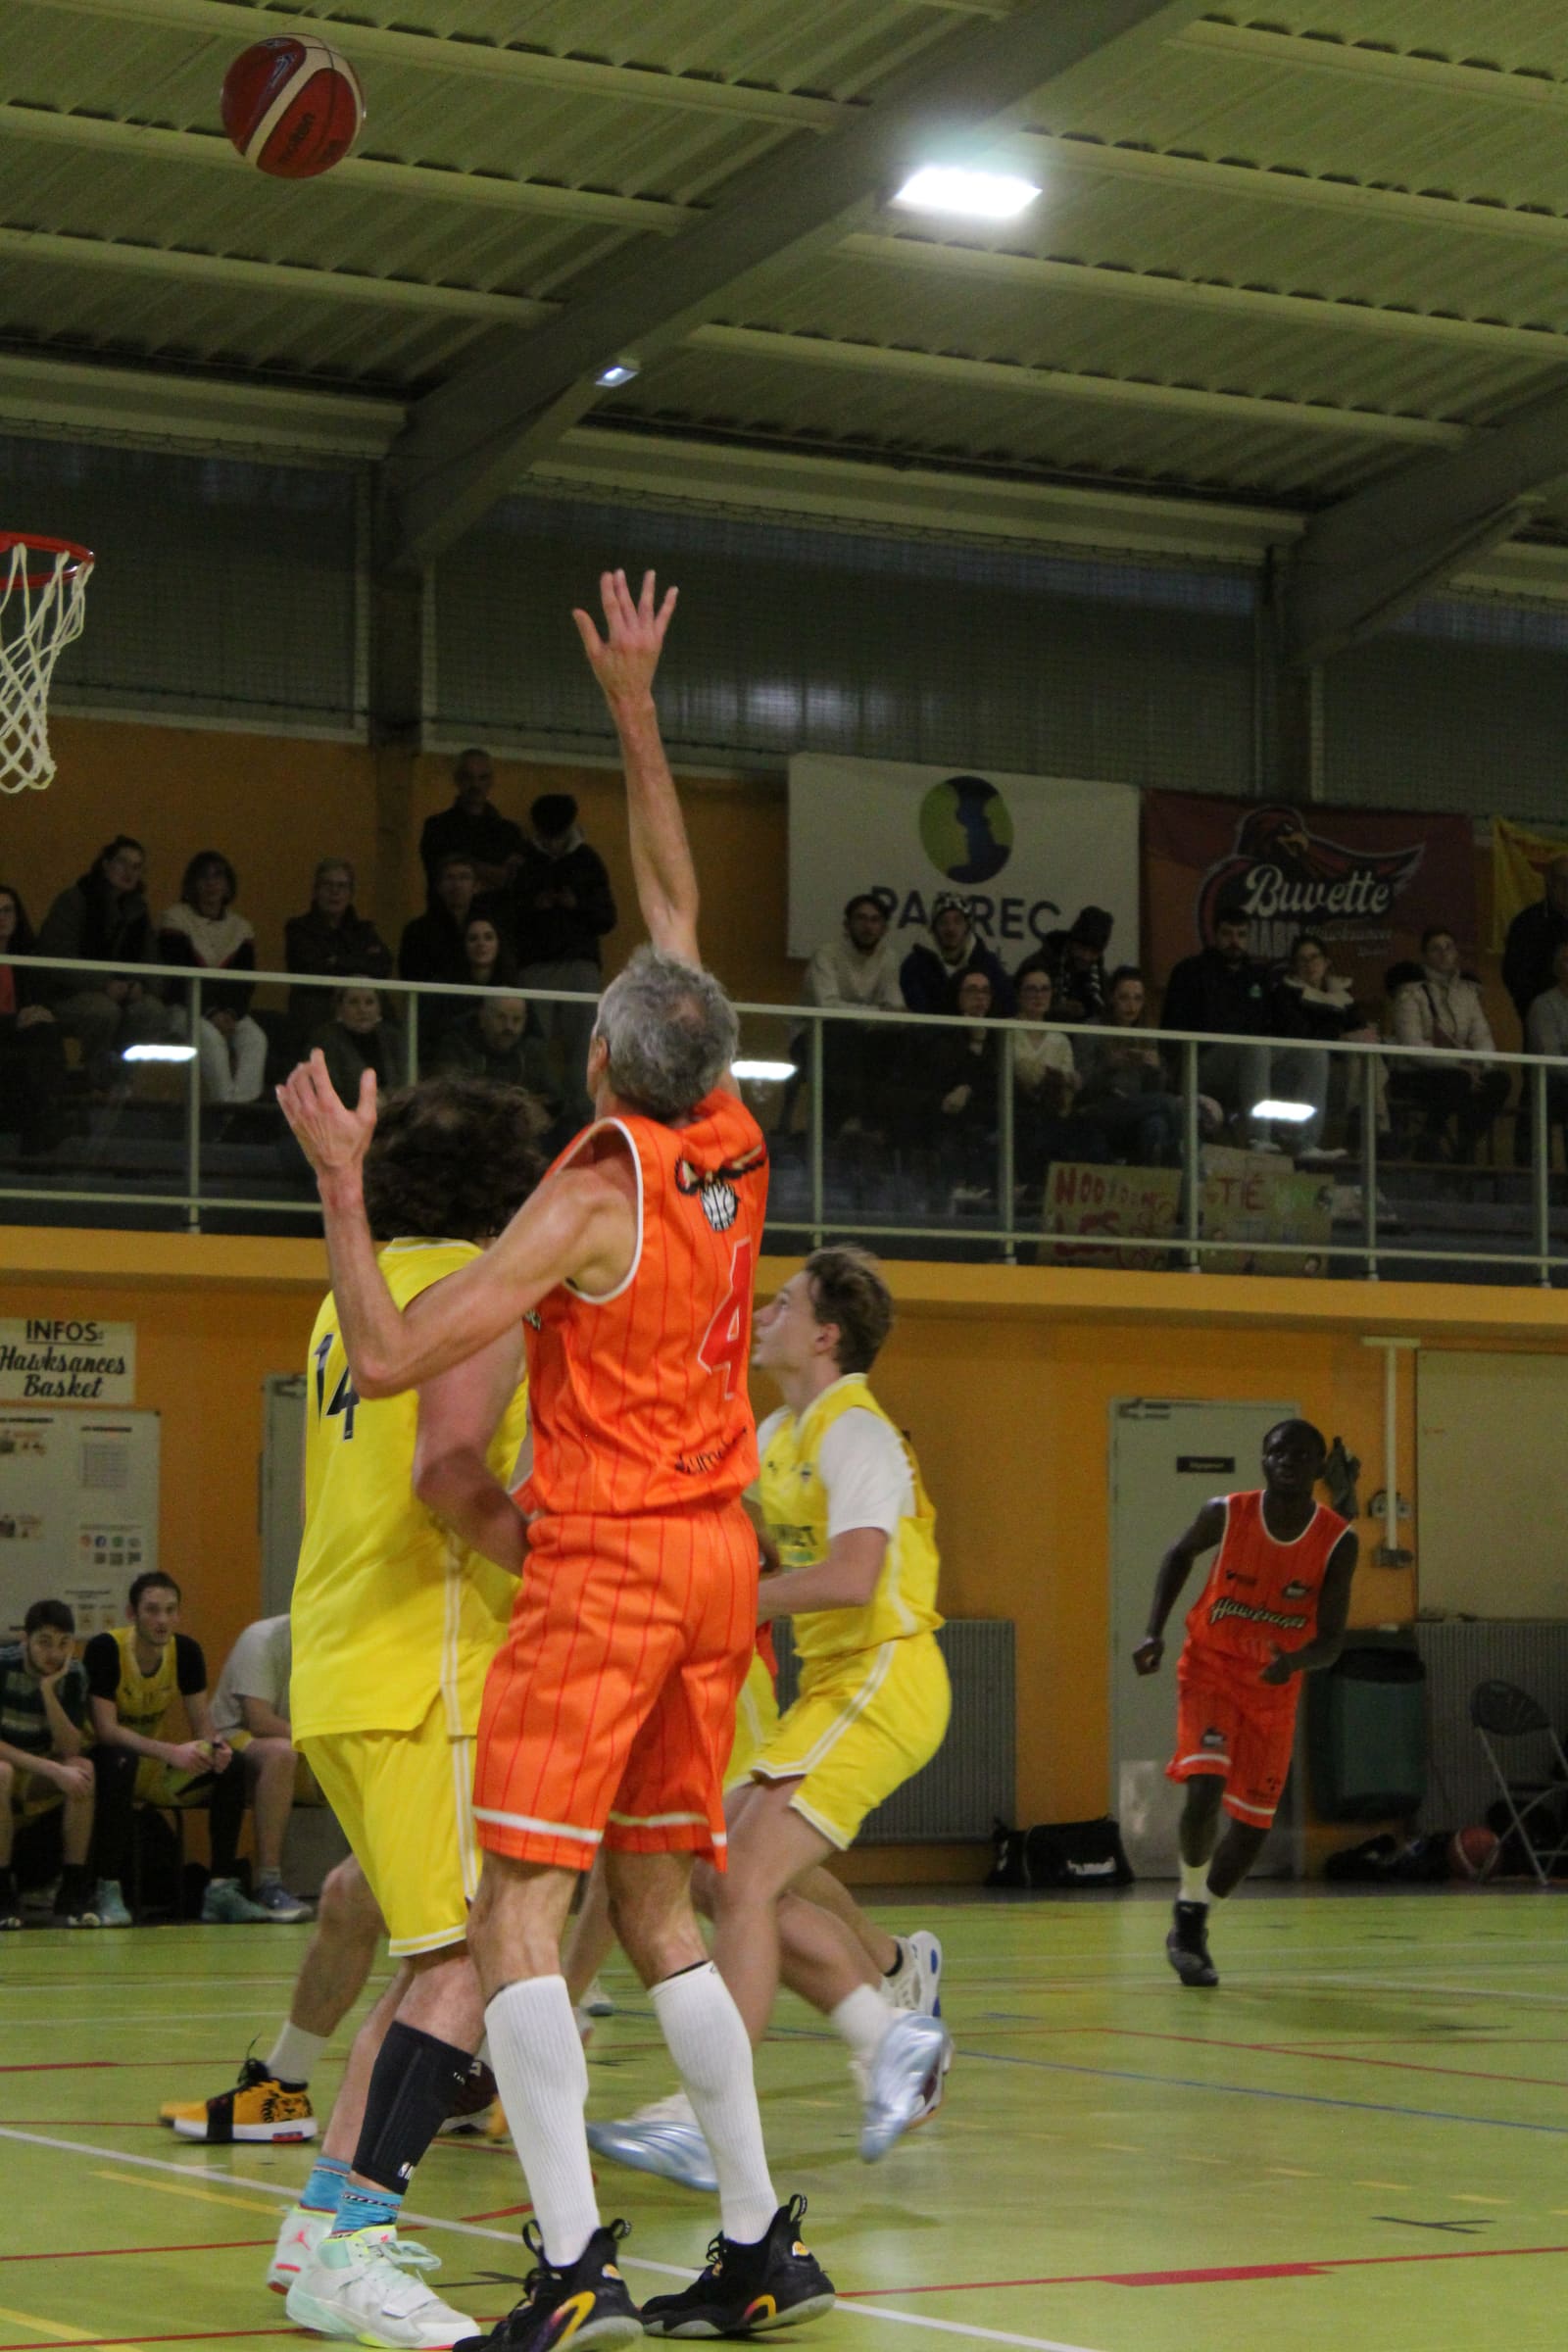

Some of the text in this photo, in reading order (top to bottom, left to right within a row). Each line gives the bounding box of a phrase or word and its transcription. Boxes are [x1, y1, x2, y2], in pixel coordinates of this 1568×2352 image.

[870, 885, 1061, 941] PAREC
[1240, 862, 1392, 918] Buvette
[697, 1235, 753, 1401] 4
[24, 1373, 104, 1399] Basket
[313, 1332, 361, 1443] 14
